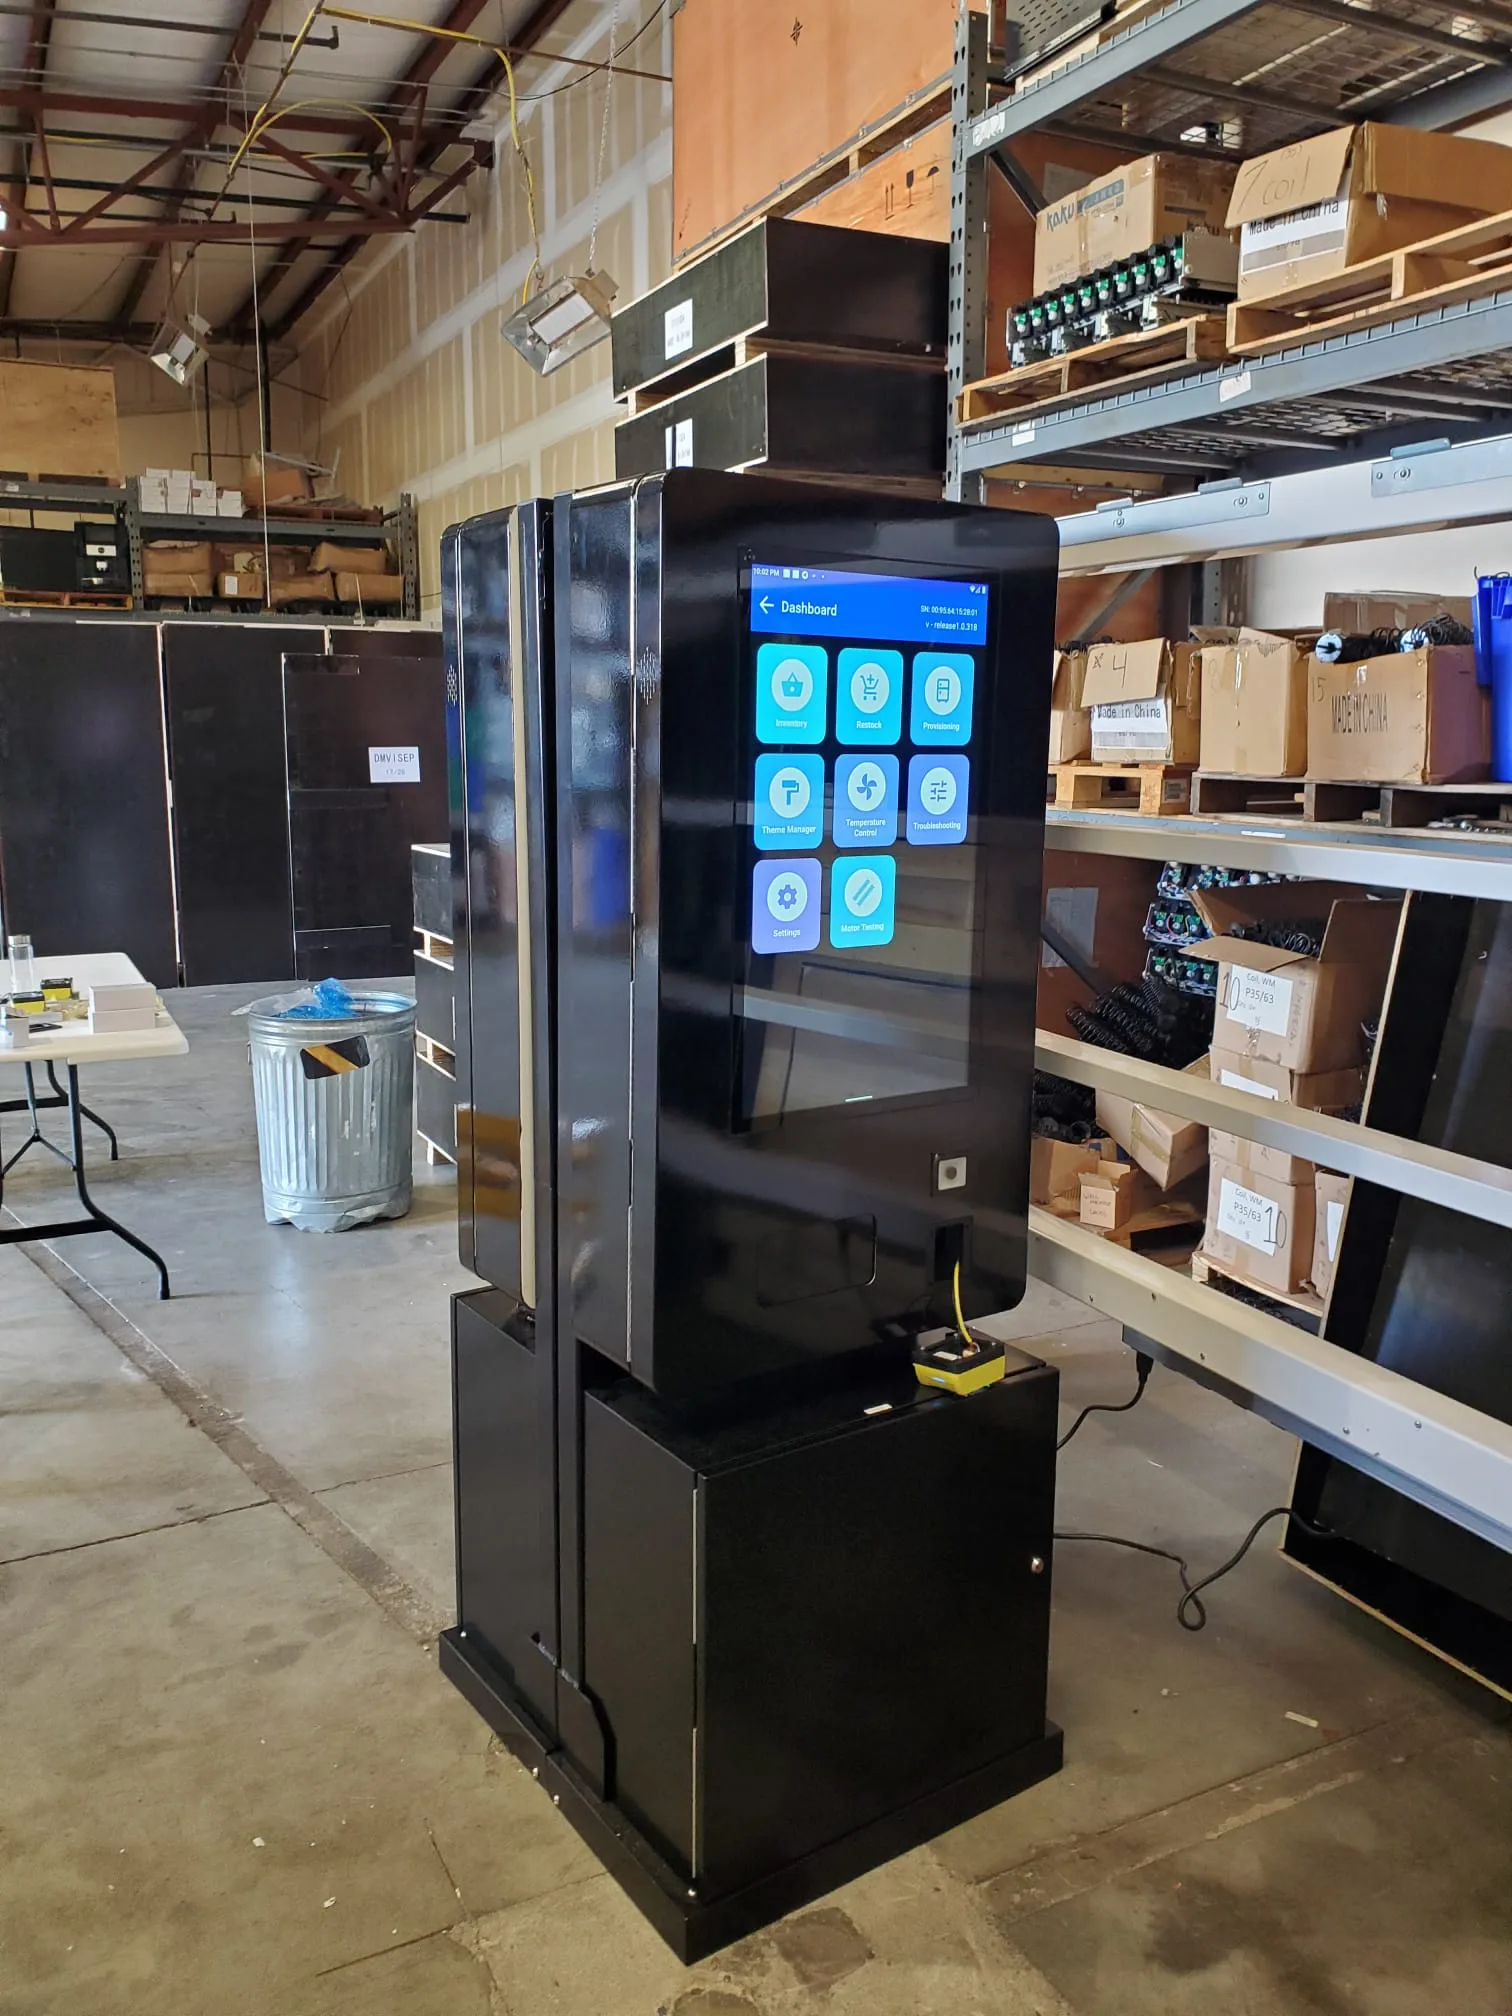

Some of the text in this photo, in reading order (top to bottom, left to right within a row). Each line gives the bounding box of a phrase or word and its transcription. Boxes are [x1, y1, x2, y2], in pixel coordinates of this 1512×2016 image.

[770, 569, 780, 577] PM
[781, 600, 838, 617] Dashboard
[1097, 703, 1161, 719] Made in China
[775, 719, 808, 729] Inventory
[856, 720, 882, 730] Restock
[922, 721, 960, 732] Provisioning
[846, 818, 886, 827] Temperature
[913, 821, 961, 831] Troubleshooting
[762, 824, 816, 835] Theme Manager
[854, 829, 877, 837] Control
[841, 921, 884, 932] Motor Testing
[773, 928, 801, 938] Settings
[1219, 971, 1240, 1011] 10
[1245, 987, 1275, 1004] P35/63
[1233, 1201, 1262, 1222] P35/63
[1263, 1205, 1288, 1249] 10
